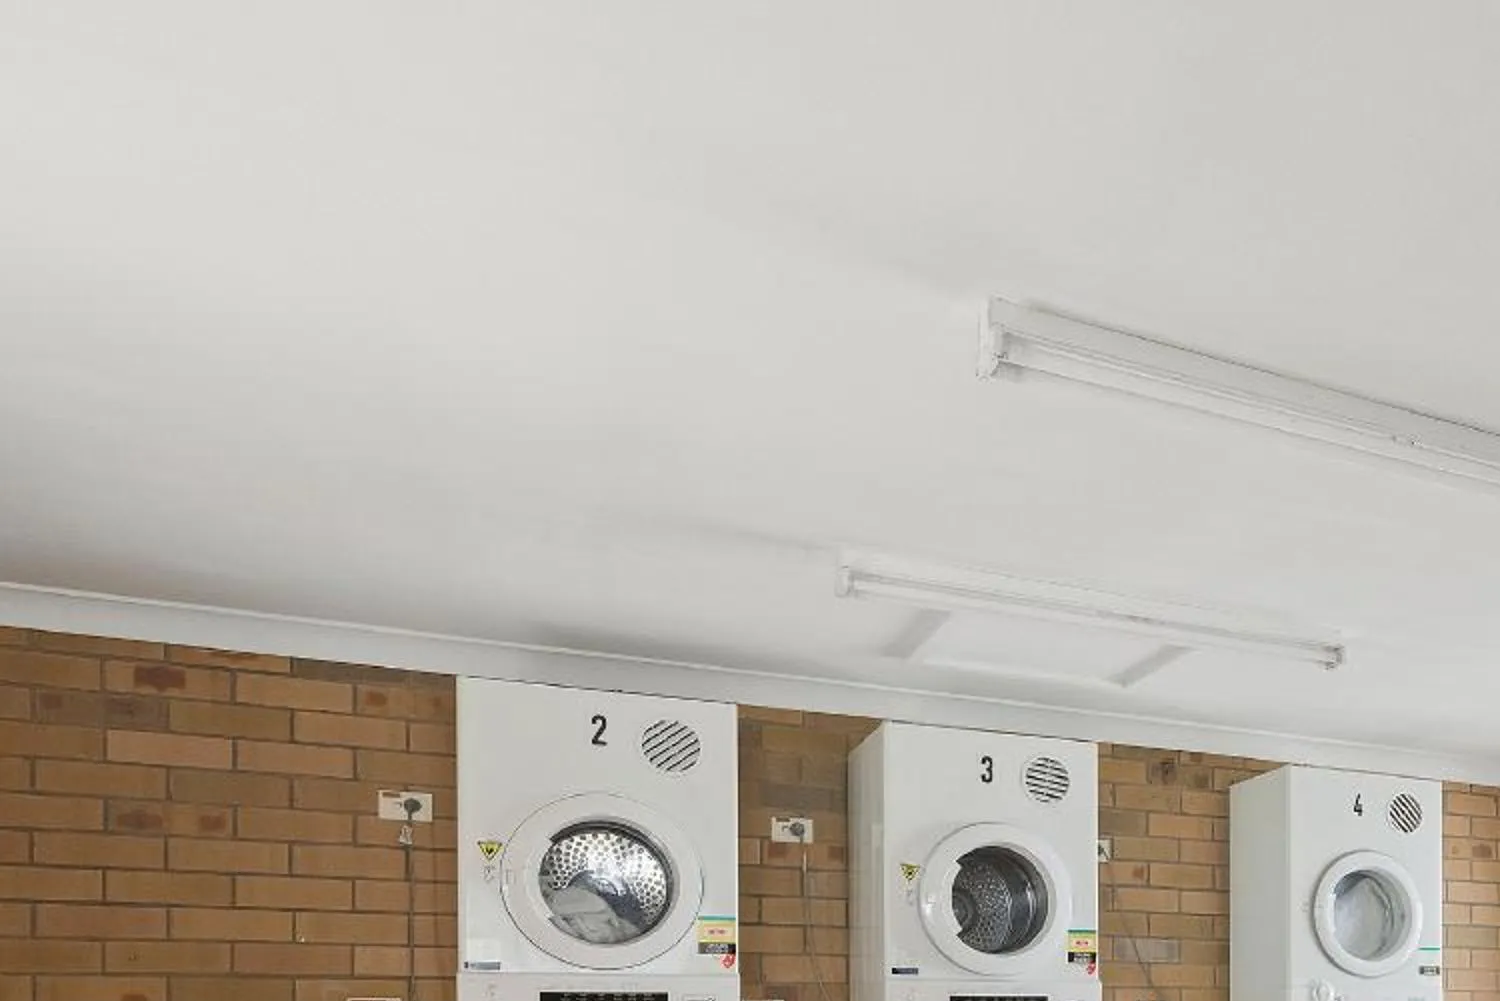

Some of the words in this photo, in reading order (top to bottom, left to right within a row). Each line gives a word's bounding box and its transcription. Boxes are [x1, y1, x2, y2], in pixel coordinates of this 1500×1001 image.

[591, 714, 608, 747] 2
[980, 755, 993, 784] 3
[1353, 793, 1363, 817] 4
